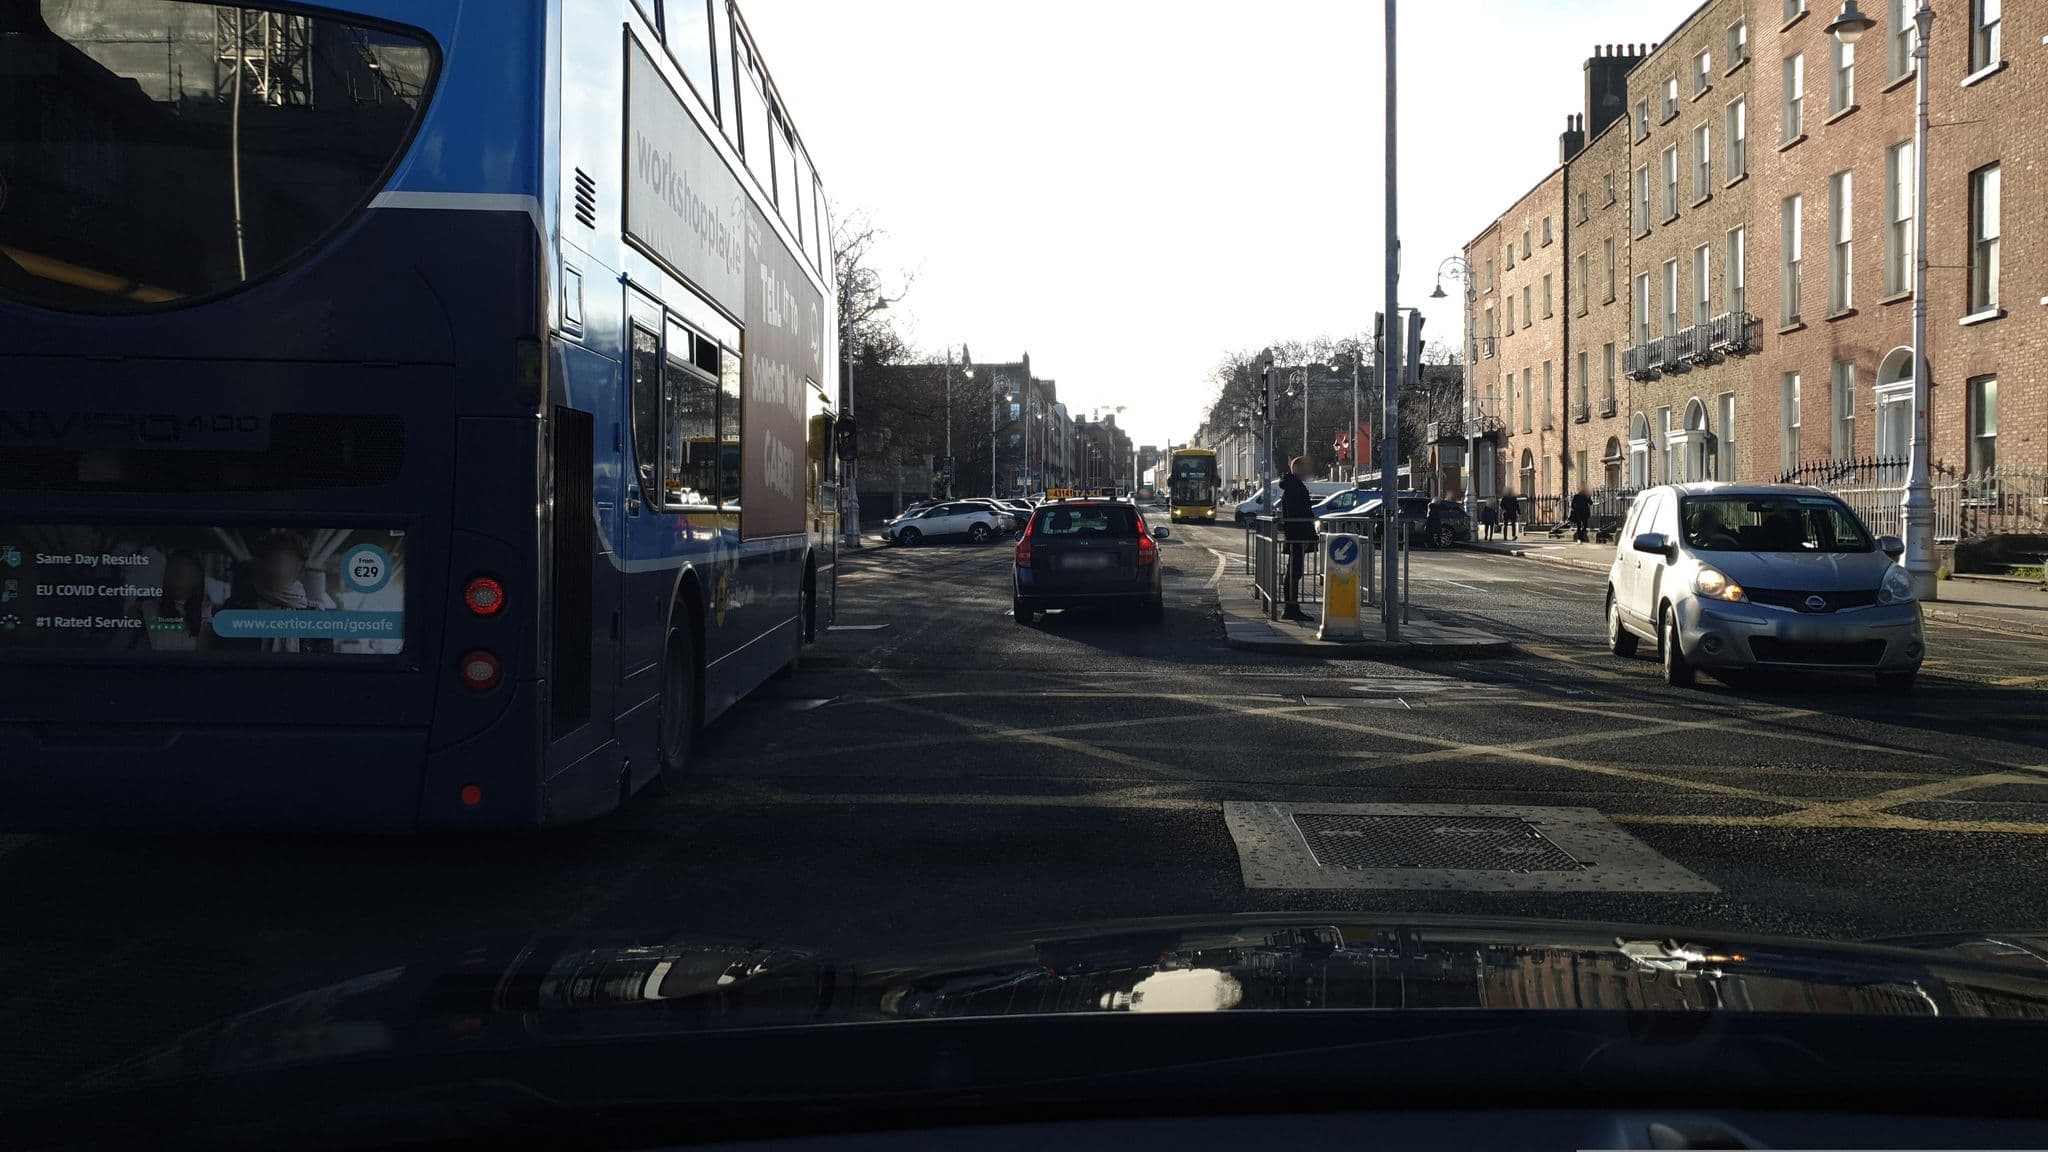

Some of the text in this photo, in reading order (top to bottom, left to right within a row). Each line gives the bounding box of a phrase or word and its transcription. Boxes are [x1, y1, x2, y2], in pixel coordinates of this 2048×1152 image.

[636, 129, 741, 275] workshopplay.ie
[1074, 489, 1100, 497] TAXI
[36, 553, 149, 568] Same Day Results
[354, 566, 379, 578] €29
[36, 585, 164, 597] EU COVID Certificate
[36, 616, 142, 628] #1 Rated Service
[232, 617, 393, 633] www.certior.com/gosafe
